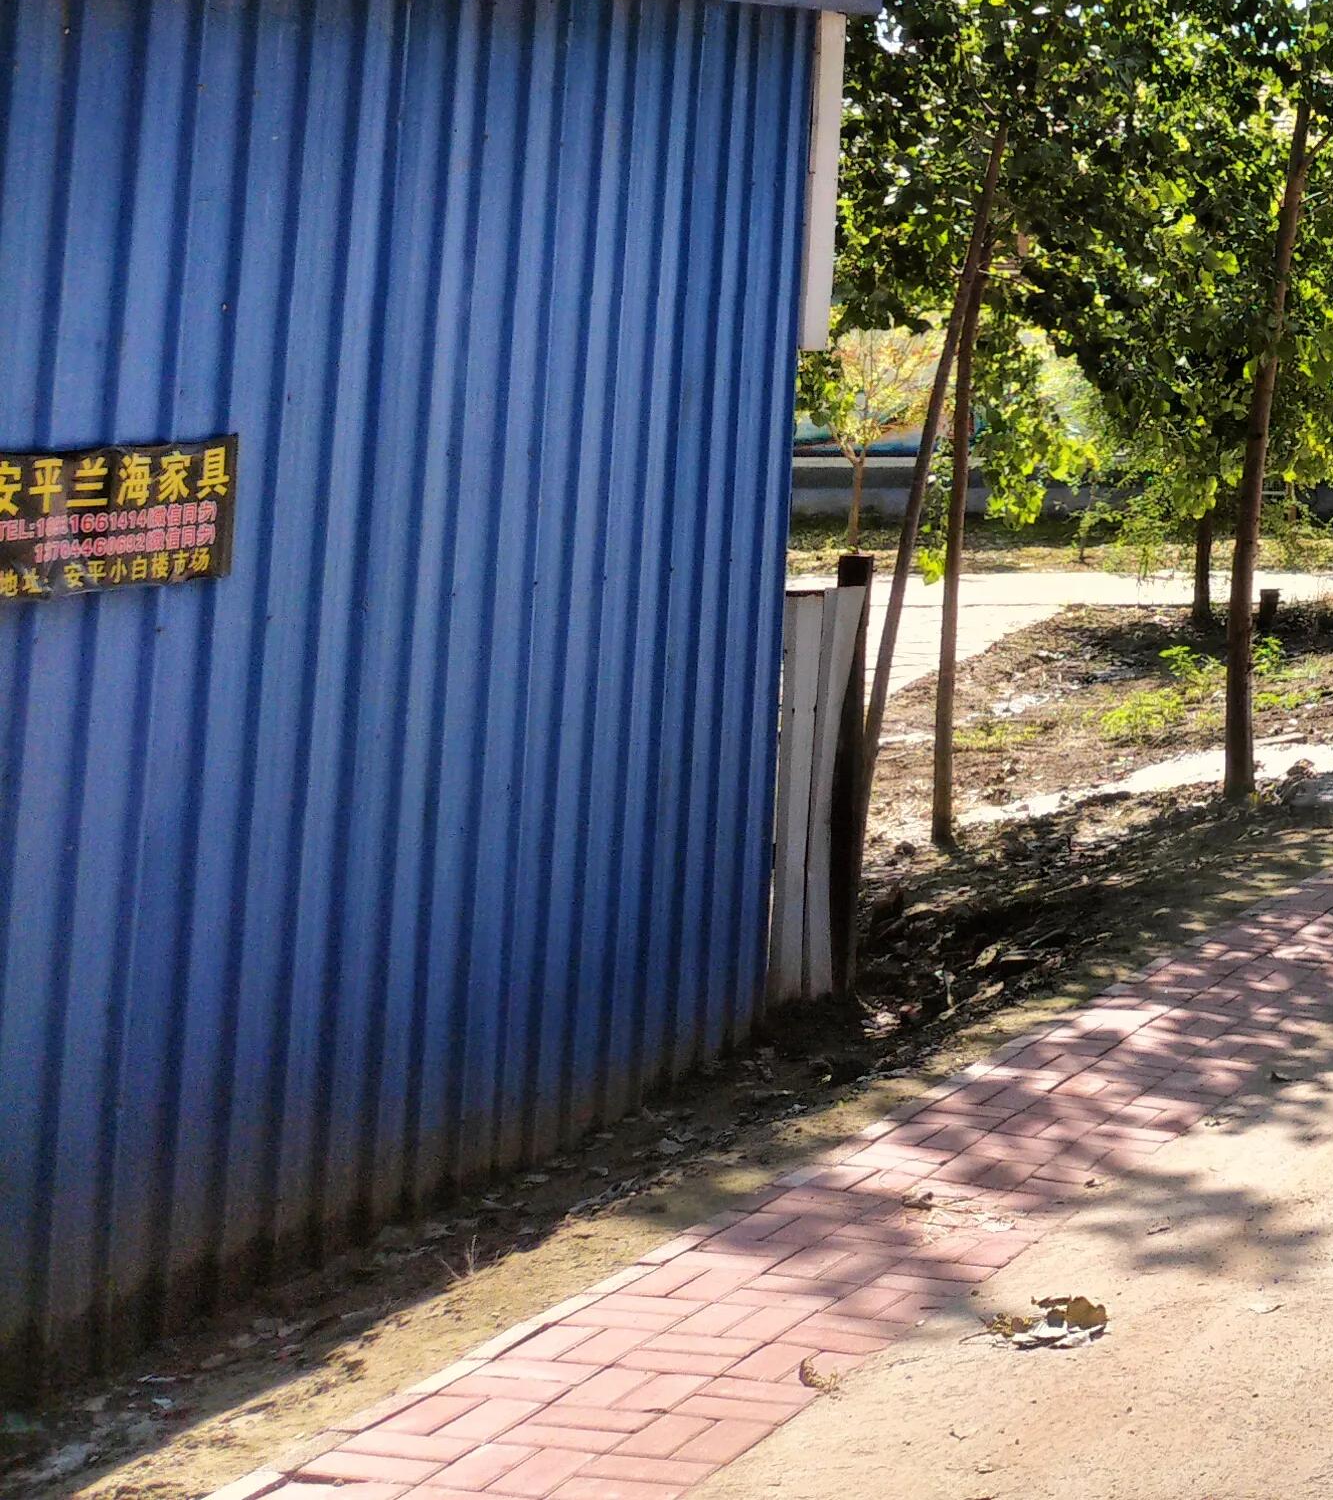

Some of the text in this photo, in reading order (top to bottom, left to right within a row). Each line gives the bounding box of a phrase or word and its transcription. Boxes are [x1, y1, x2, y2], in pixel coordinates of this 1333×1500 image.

[0, 447, 230, 516] 安平兰海家具
